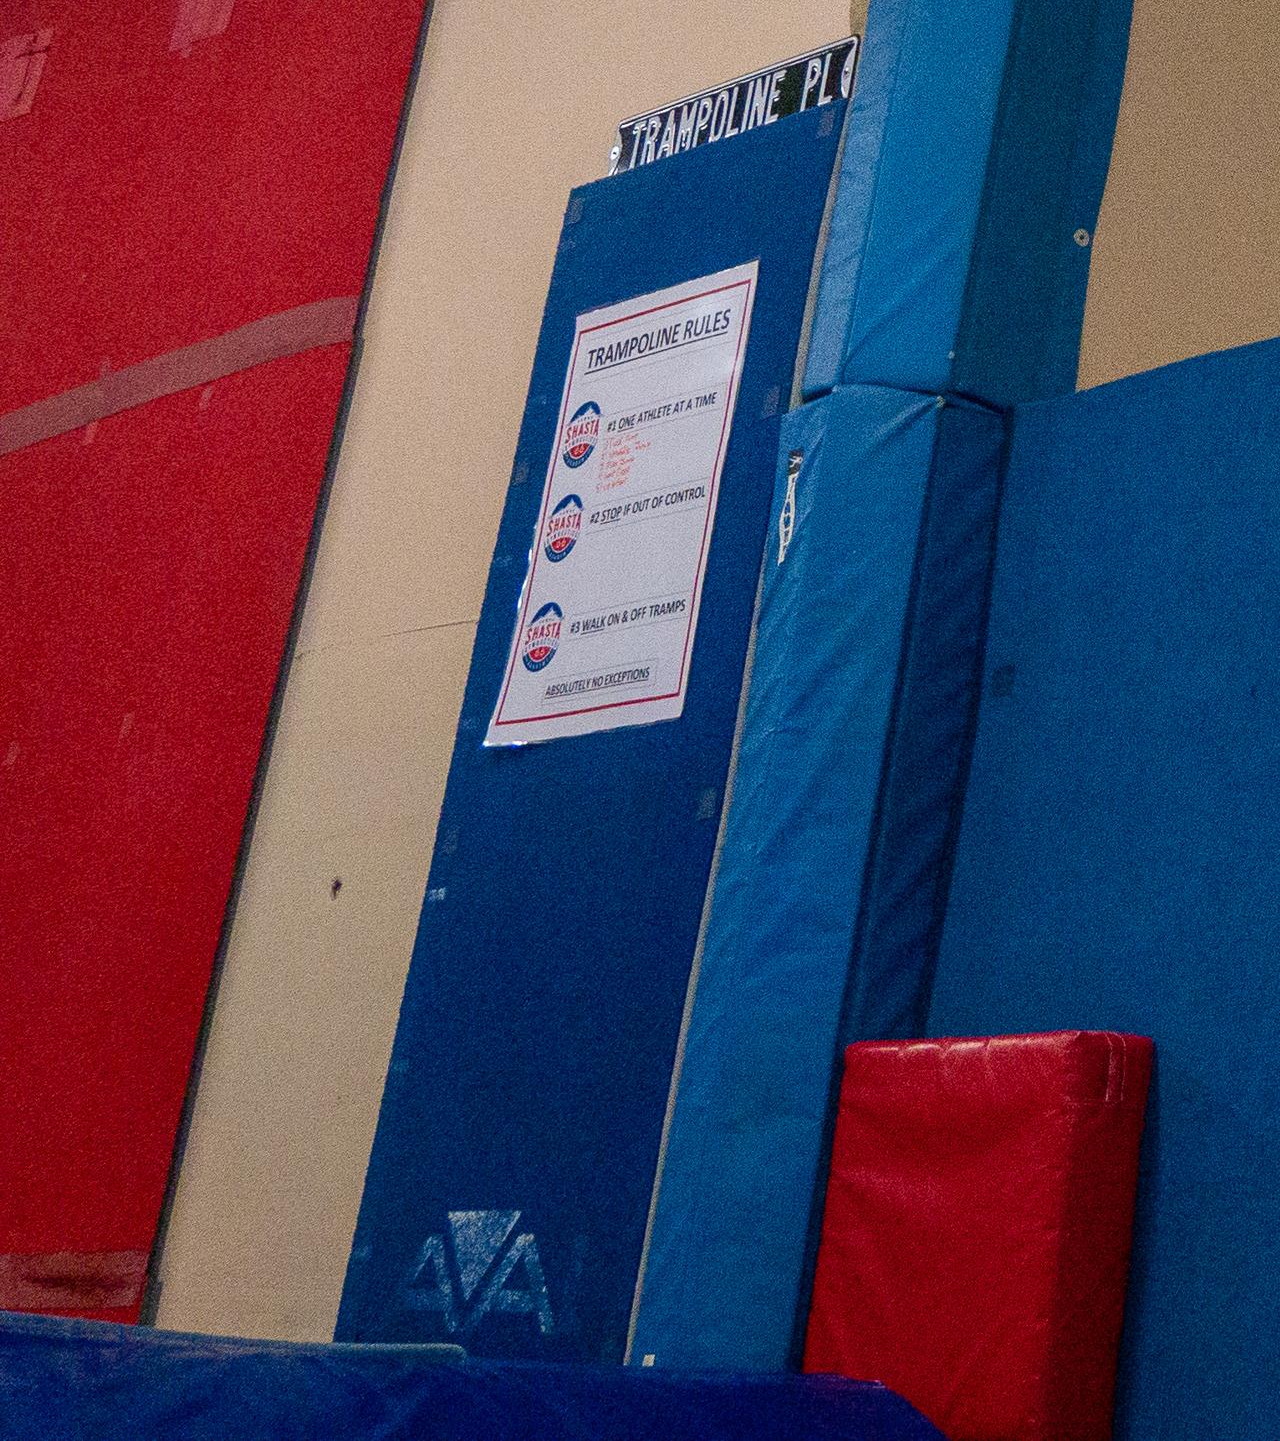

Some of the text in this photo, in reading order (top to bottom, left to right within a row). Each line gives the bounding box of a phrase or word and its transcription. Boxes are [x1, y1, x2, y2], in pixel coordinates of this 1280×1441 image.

[800, 52, 834, 113] PL
[588, 309, 731, 368] TRAMPOLINE RULES
[607, 392, 717, 432] #1 ONE ATHLETE AT A TIME
[590, 485, 705, 524] #2 STOP IF OUT OF CONTROL
[570, 599, 686, 634] #3 WALK ON & OFF TRAMPS
[546, 667, 650, 696] ABSOLUTELY NO EXCEPTIONS
